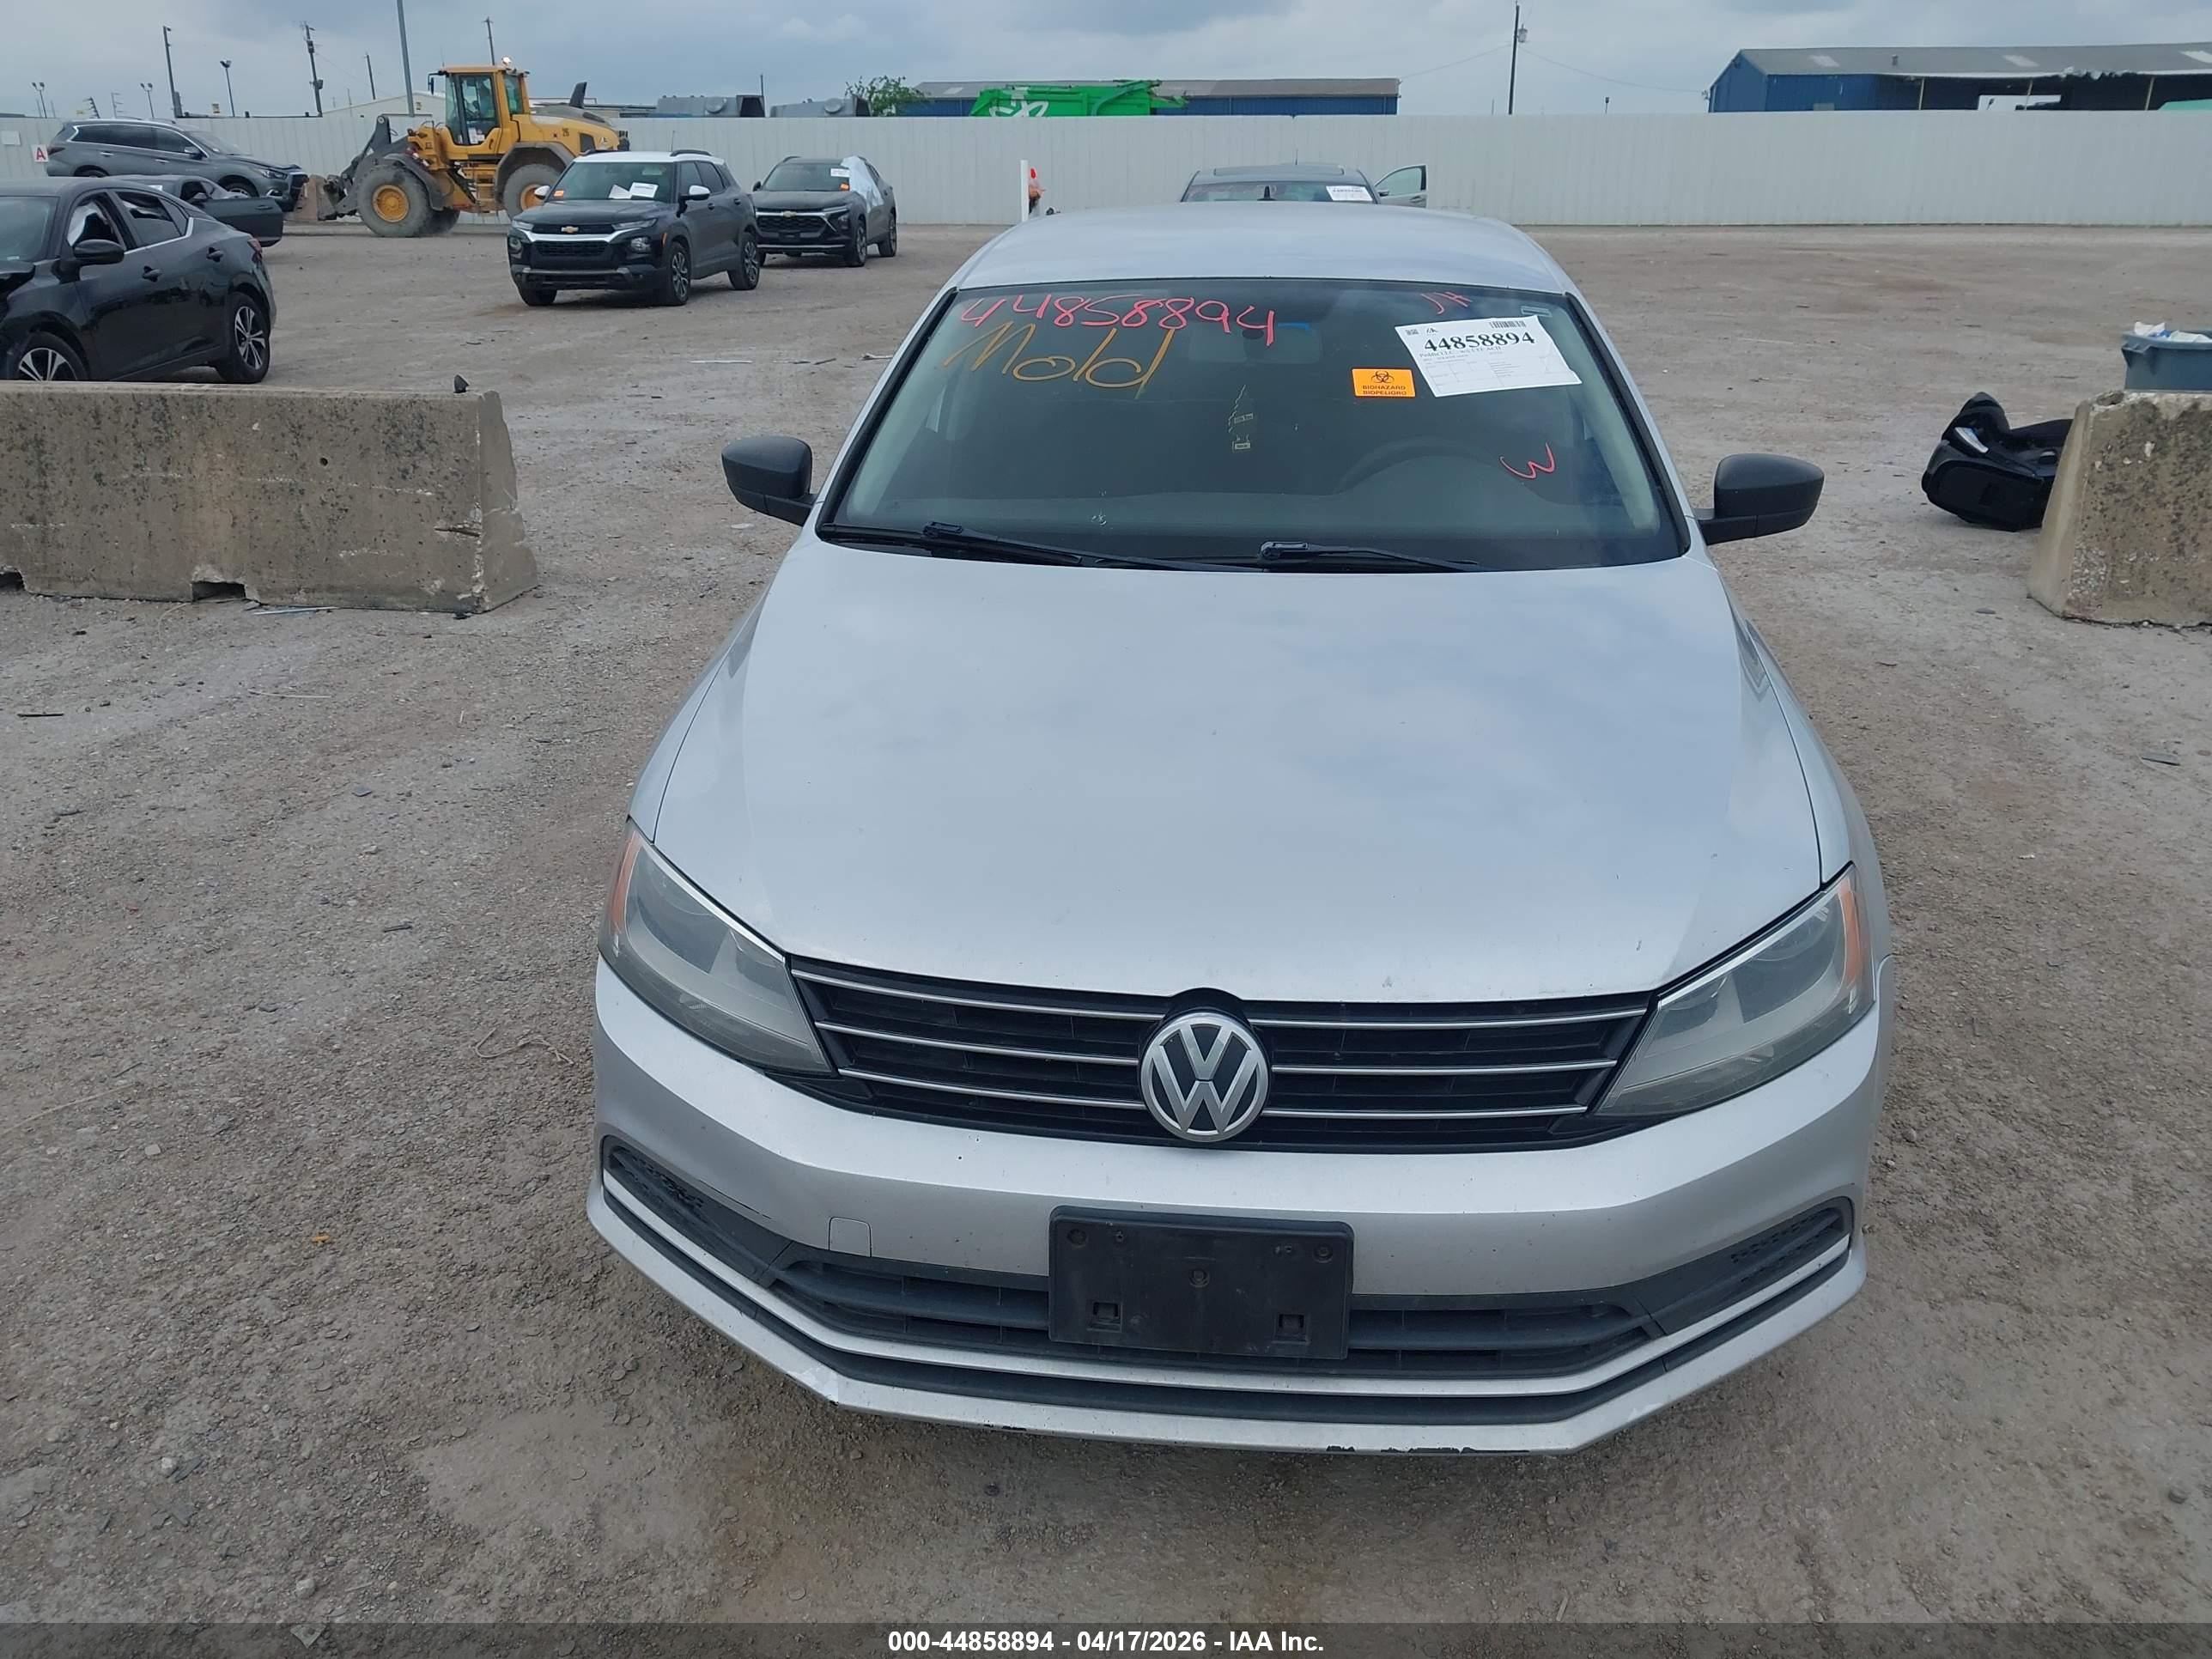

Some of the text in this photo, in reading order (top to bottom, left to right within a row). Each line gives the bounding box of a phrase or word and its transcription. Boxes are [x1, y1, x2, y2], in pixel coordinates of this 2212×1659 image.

[36, 147, 46, 161] A
[961, 294, 1275, 347] 44858894
[942, 320, 1176, 400] Mold
[1424, 331, 1536, 352] 44858894
